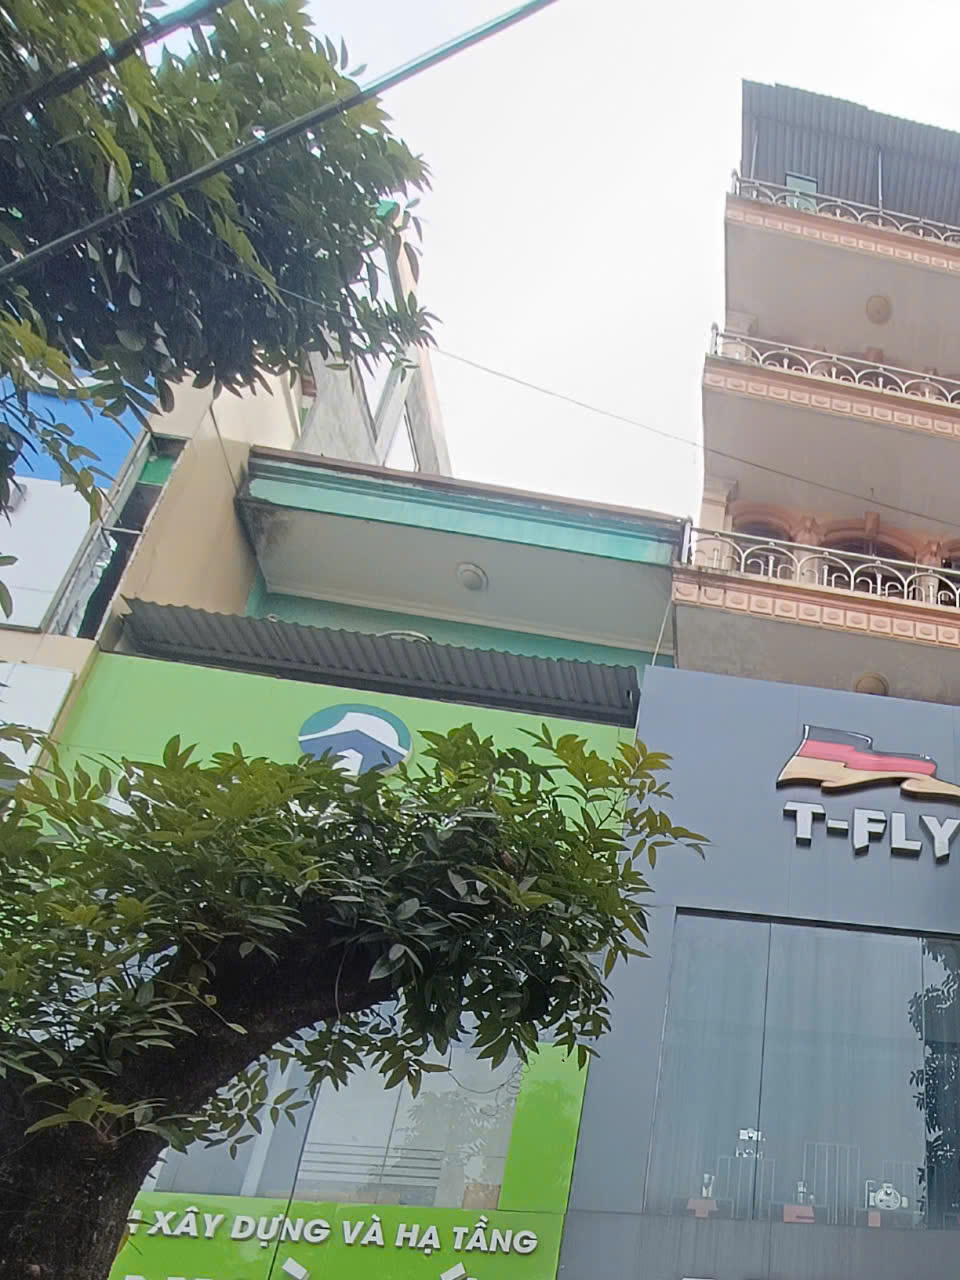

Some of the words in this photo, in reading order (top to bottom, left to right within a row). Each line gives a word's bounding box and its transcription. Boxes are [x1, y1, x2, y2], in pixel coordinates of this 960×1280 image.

[783, 801, 960, 863] T-FLY
[147, 1206, 224, 1239] XÂY
[230, 1213, 330, 1249] DỰNG
[342, 1213, 384, 1246] VÀ
[394, 1224, 442, 1254] HẠ
[452, 1215, 538, 1254] TẦNG
